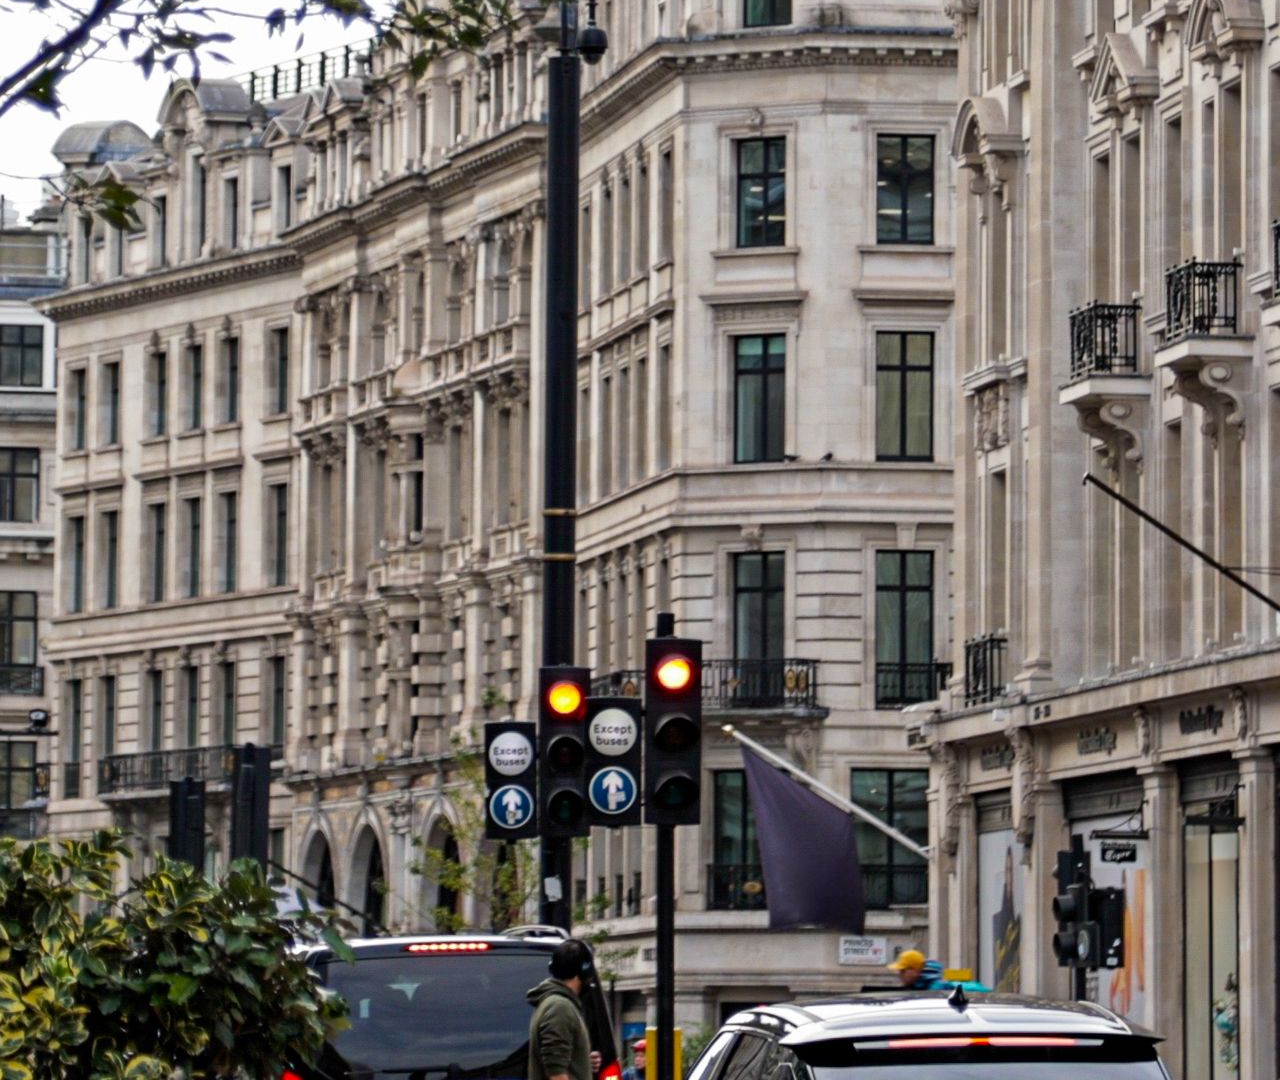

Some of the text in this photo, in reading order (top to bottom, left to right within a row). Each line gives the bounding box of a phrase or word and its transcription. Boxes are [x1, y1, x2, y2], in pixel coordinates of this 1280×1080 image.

[593, 723, 632, 736] Except
[596, 735, 629, 746] buses
[493, 746, 529, 758] Except
[495, 756, 527, 767] buses
